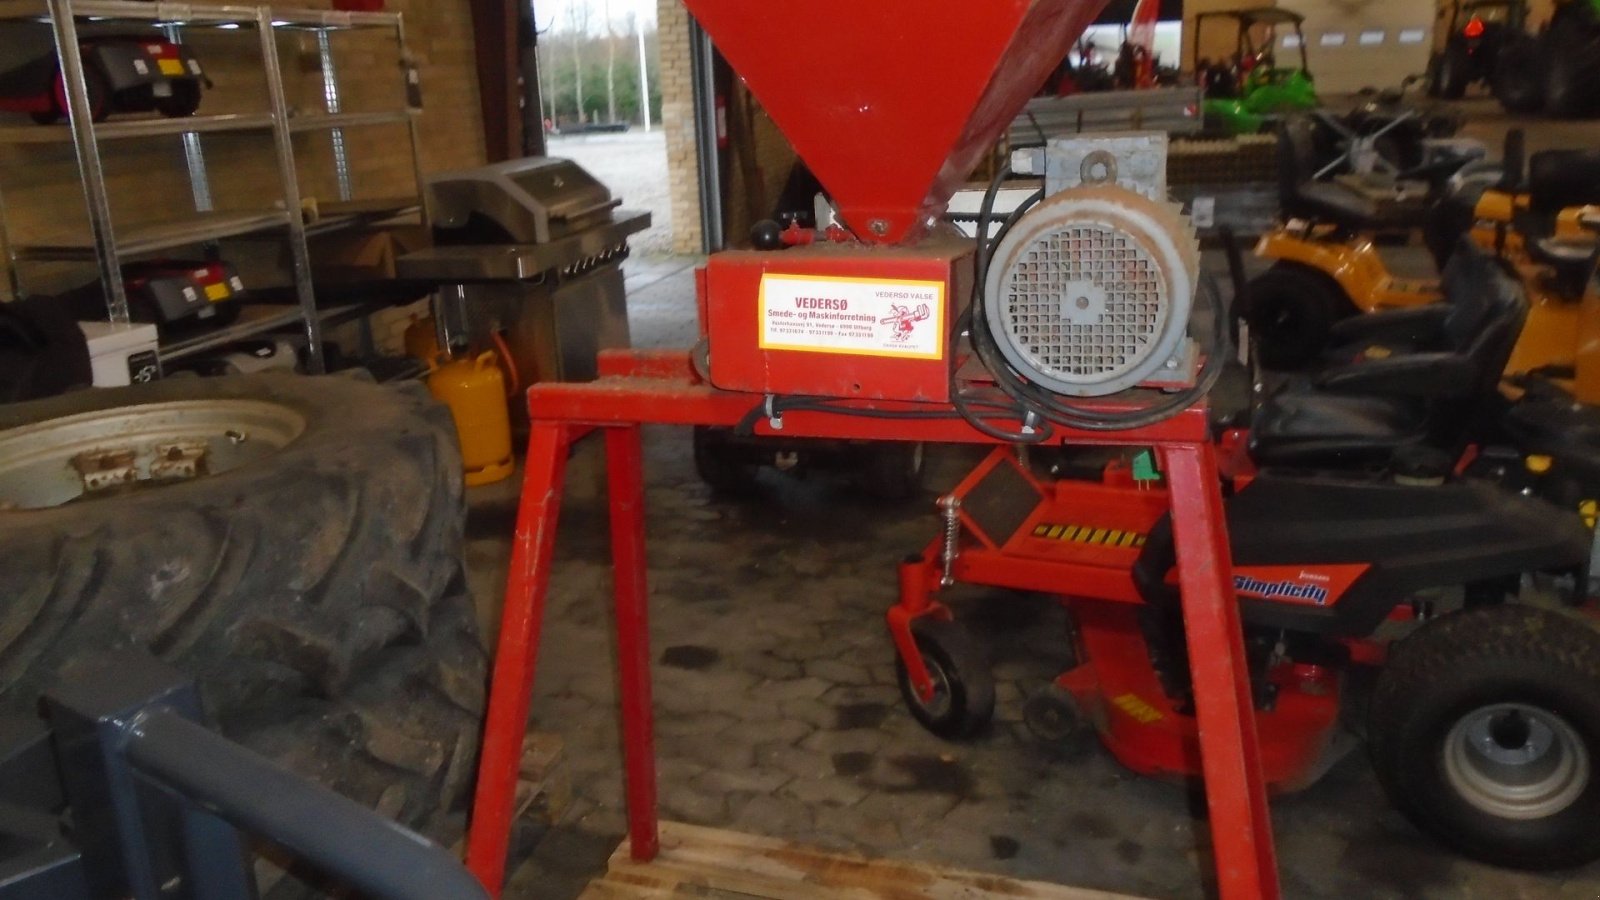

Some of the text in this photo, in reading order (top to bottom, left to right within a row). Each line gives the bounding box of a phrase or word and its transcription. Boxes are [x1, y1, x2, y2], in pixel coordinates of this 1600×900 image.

[795, 296, 848, 311] VEDERSØ
[910, 292, 934, 300] VALSE
[767, 308, 876, 323] Smede- og Maskinforretning
[1233, 575, 1328, 606] Simplicity
